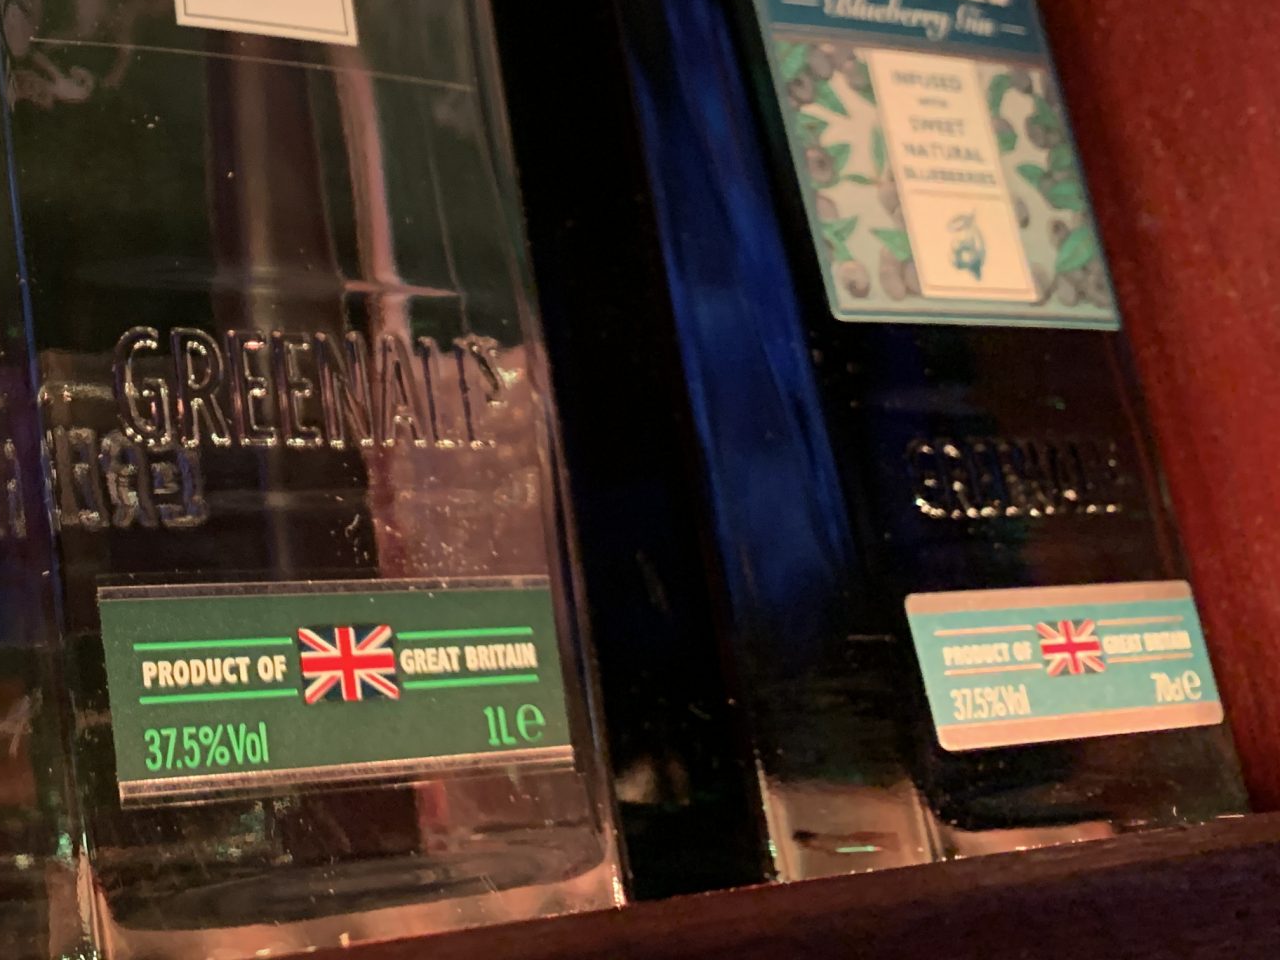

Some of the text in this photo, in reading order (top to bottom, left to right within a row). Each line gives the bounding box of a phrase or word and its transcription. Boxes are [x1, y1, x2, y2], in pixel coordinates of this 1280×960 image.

[141, 653, 288, 690] PRODUCT OF
[399, 641, 538, 676] GREAT BRITAIN
